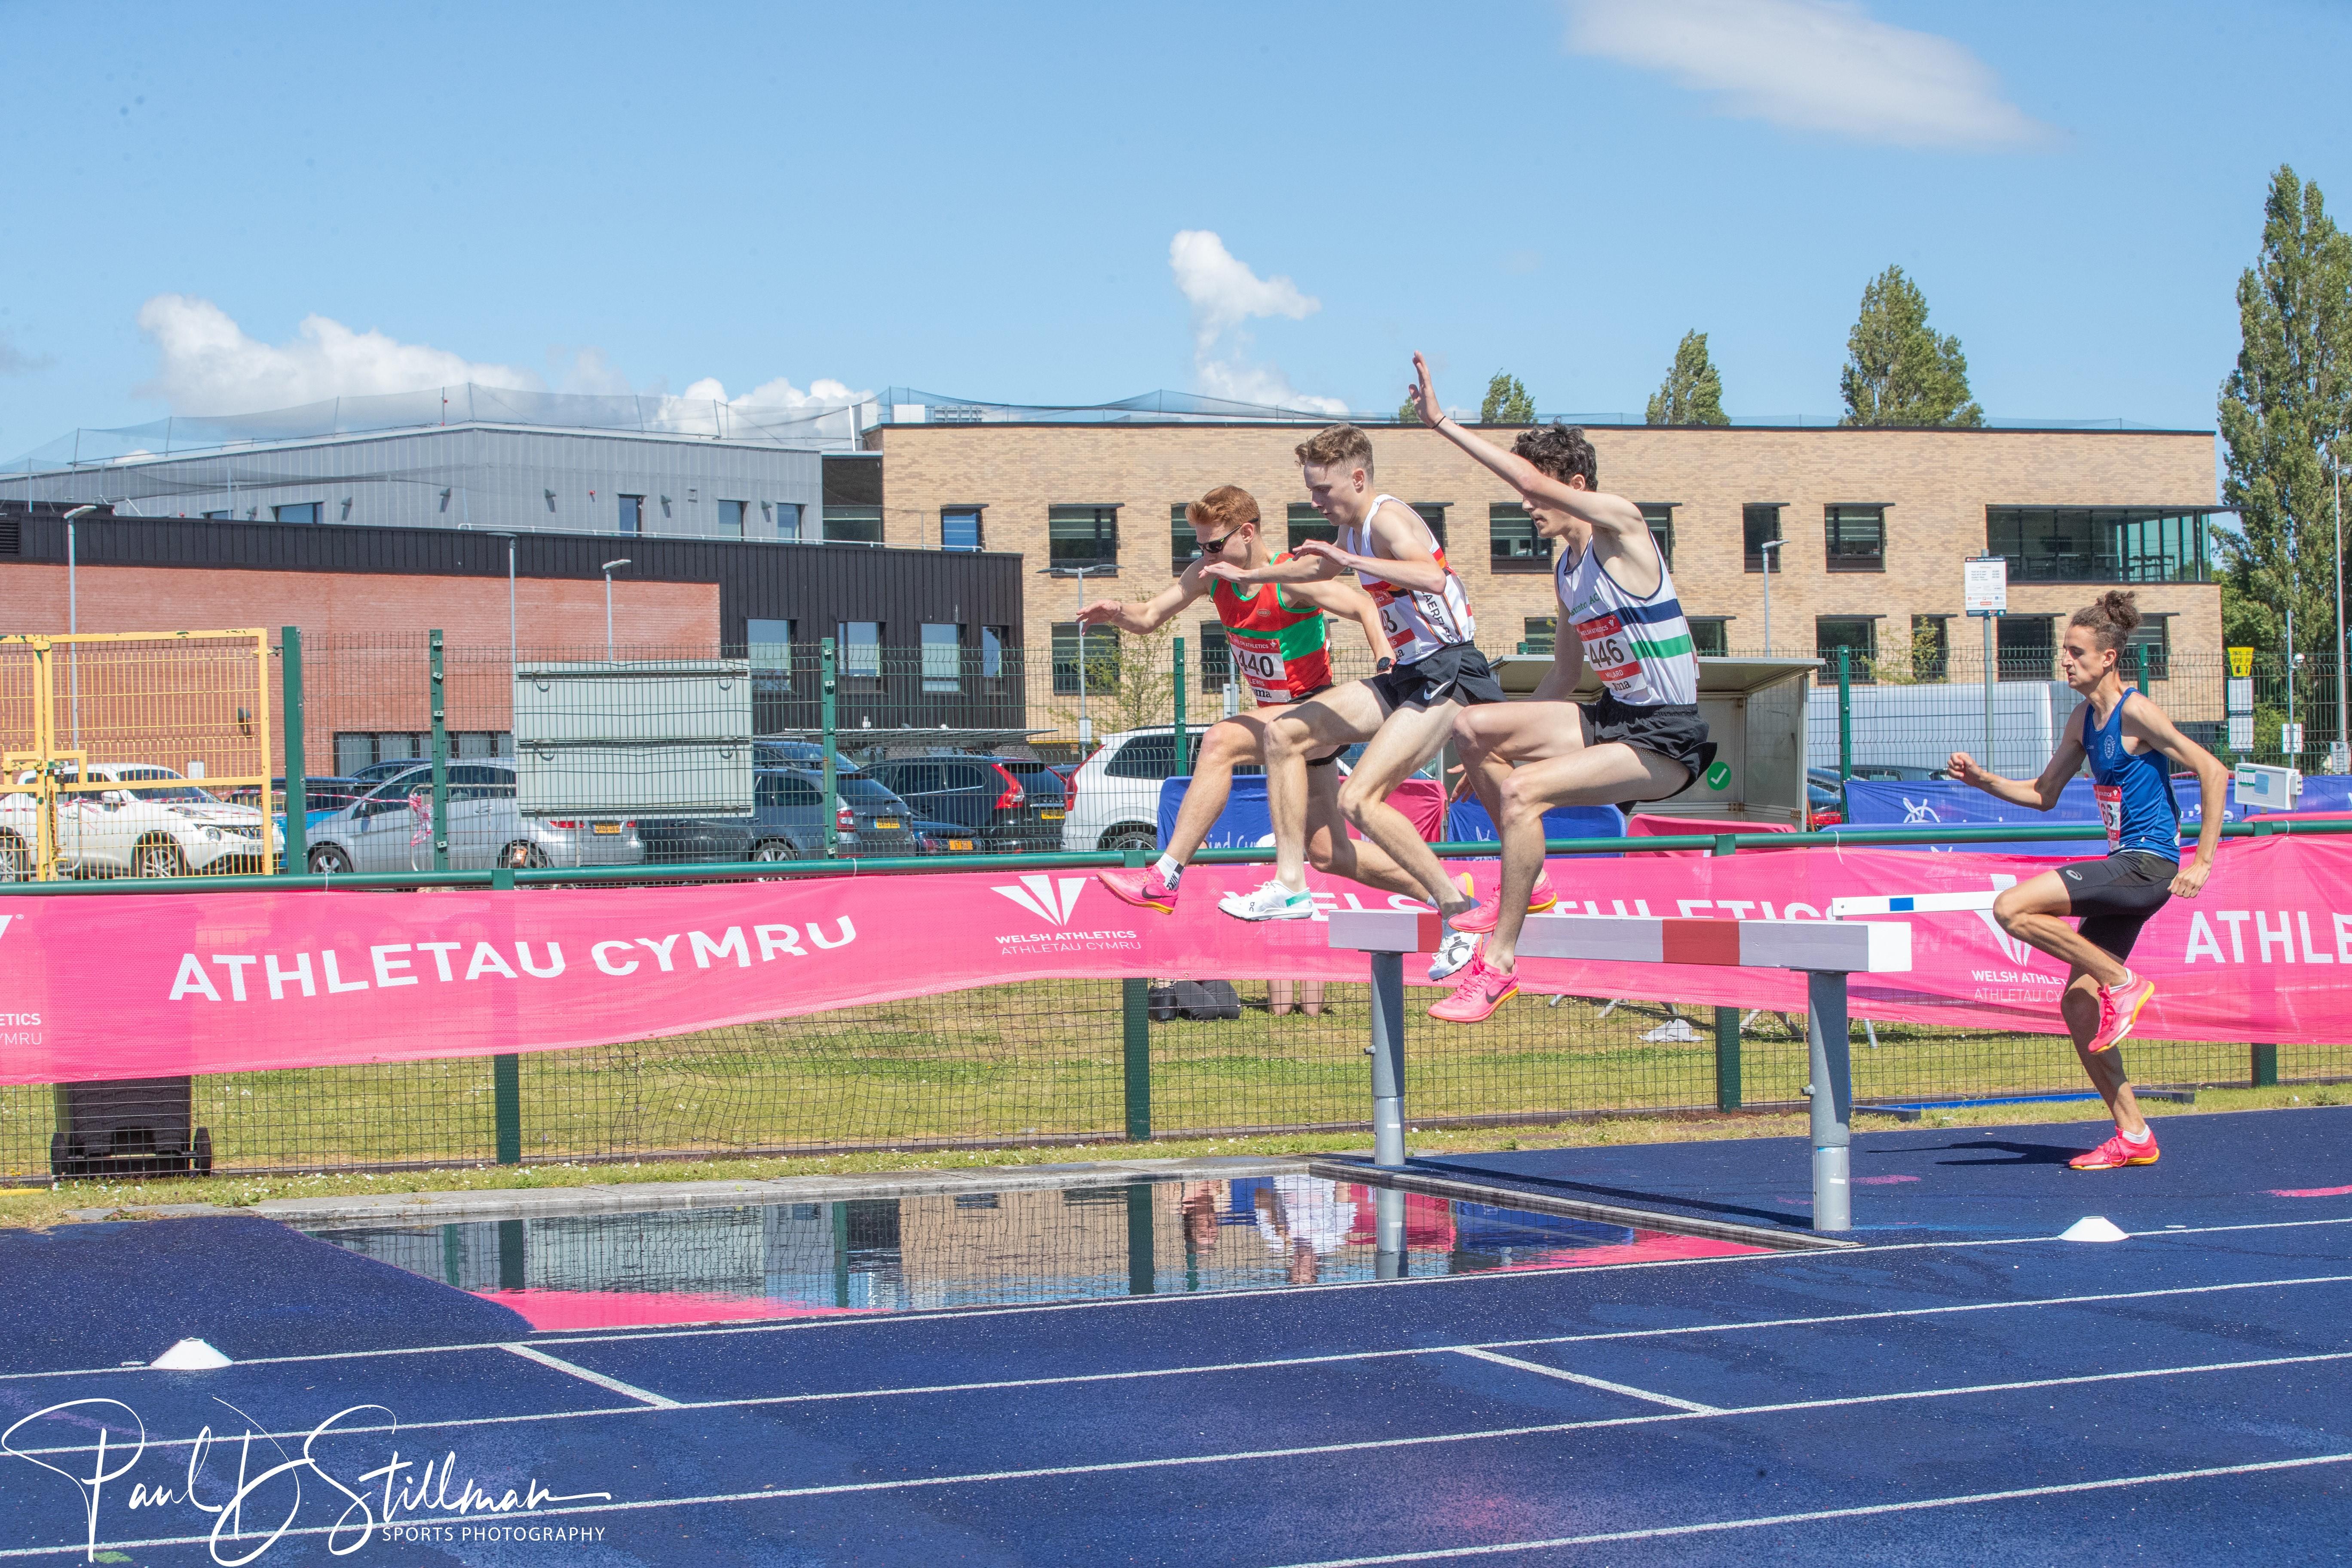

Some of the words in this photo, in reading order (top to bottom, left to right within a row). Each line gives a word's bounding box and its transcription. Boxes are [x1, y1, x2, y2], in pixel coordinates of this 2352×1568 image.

[1571, 601, 1587, 616] aunto
[1589, 638, 1624, 668] 446
[1238, 650, 1274, 678] 440
[1249, 678, 1265, 686] LEWIS
[1252, 688, 1272, 698] oma
[995, 933, 1051, 944] WELSH
[1055, 930, 1137, 941] ATHLETICS
[1001, 942, 1081, 956] ATHLETAU
[1086, 941, 1141, 951] CYMRU
[168, 941, 566, 1002] ATHLETAU
[590, 915, 858, 976] CYMRU
[1971, 970, 2019, 983] WELSH
[2021, 972, 2068, 986] ATHLET
[1974, 988, 2042, 1002] ATHLETAU
[2046, 990, 2063, 1003] CY
[0, 1013, 41, 1026] ETICS
[0, 1032, 42, 1046] MRU
